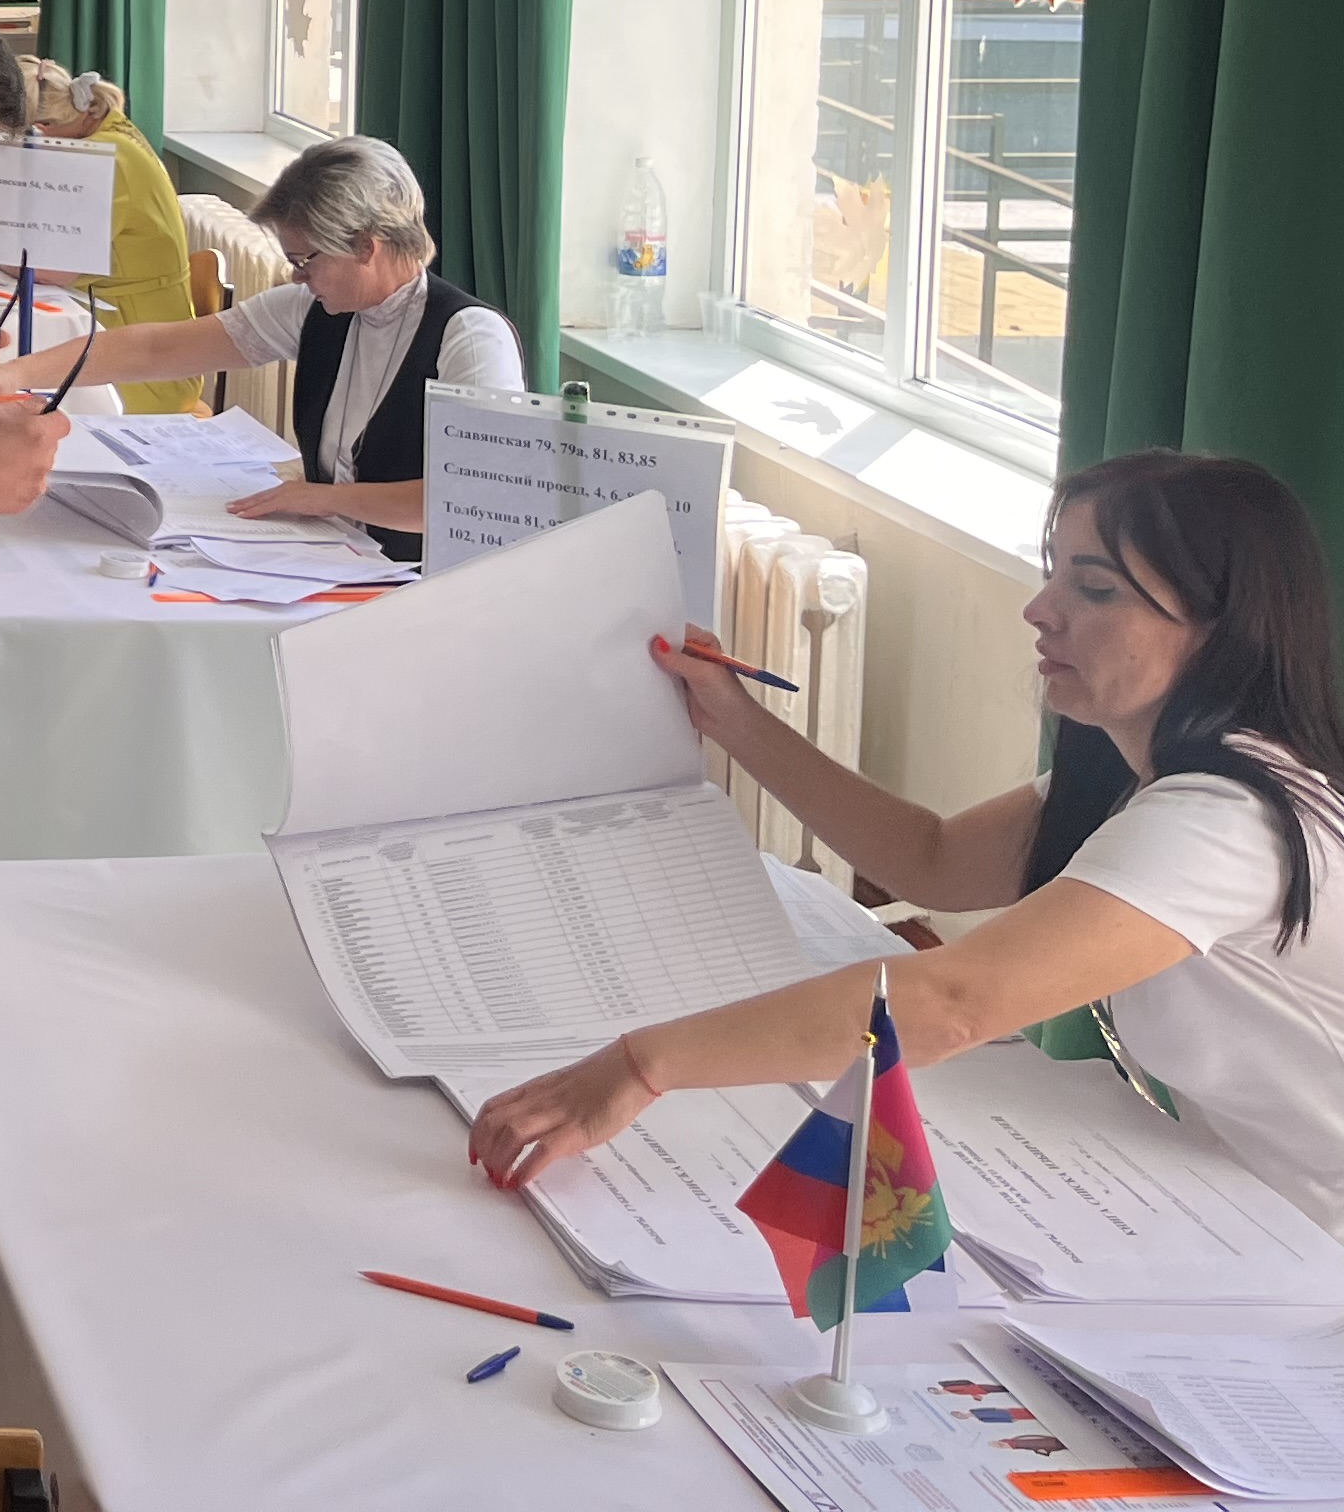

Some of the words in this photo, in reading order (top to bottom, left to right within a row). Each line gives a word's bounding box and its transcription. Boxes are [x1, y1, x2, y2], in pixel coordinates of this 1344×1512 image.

[72, 185, 83, 193] 67
[444, 424, 531, 449] Славянская
[535, 440, 556, 454] 79,
[560, 442, 588, 459] 79а,
[593, 447, 614, 463] 81,
[618, 451, 657, 468] 83,85
[444, 462, 532, 487] Славянский
[536, 478, 590, 498] проезд,
[594, 487, 606, 500] 4,
[442, 501, 520, 525] Толбухина
[524, 514, 545, 529] 81,
[449, 528, 475, 543] 102,
[671, 1165, 711, 1203] СПИСКА
[708, 1205, 744, 1236] КНИГА
